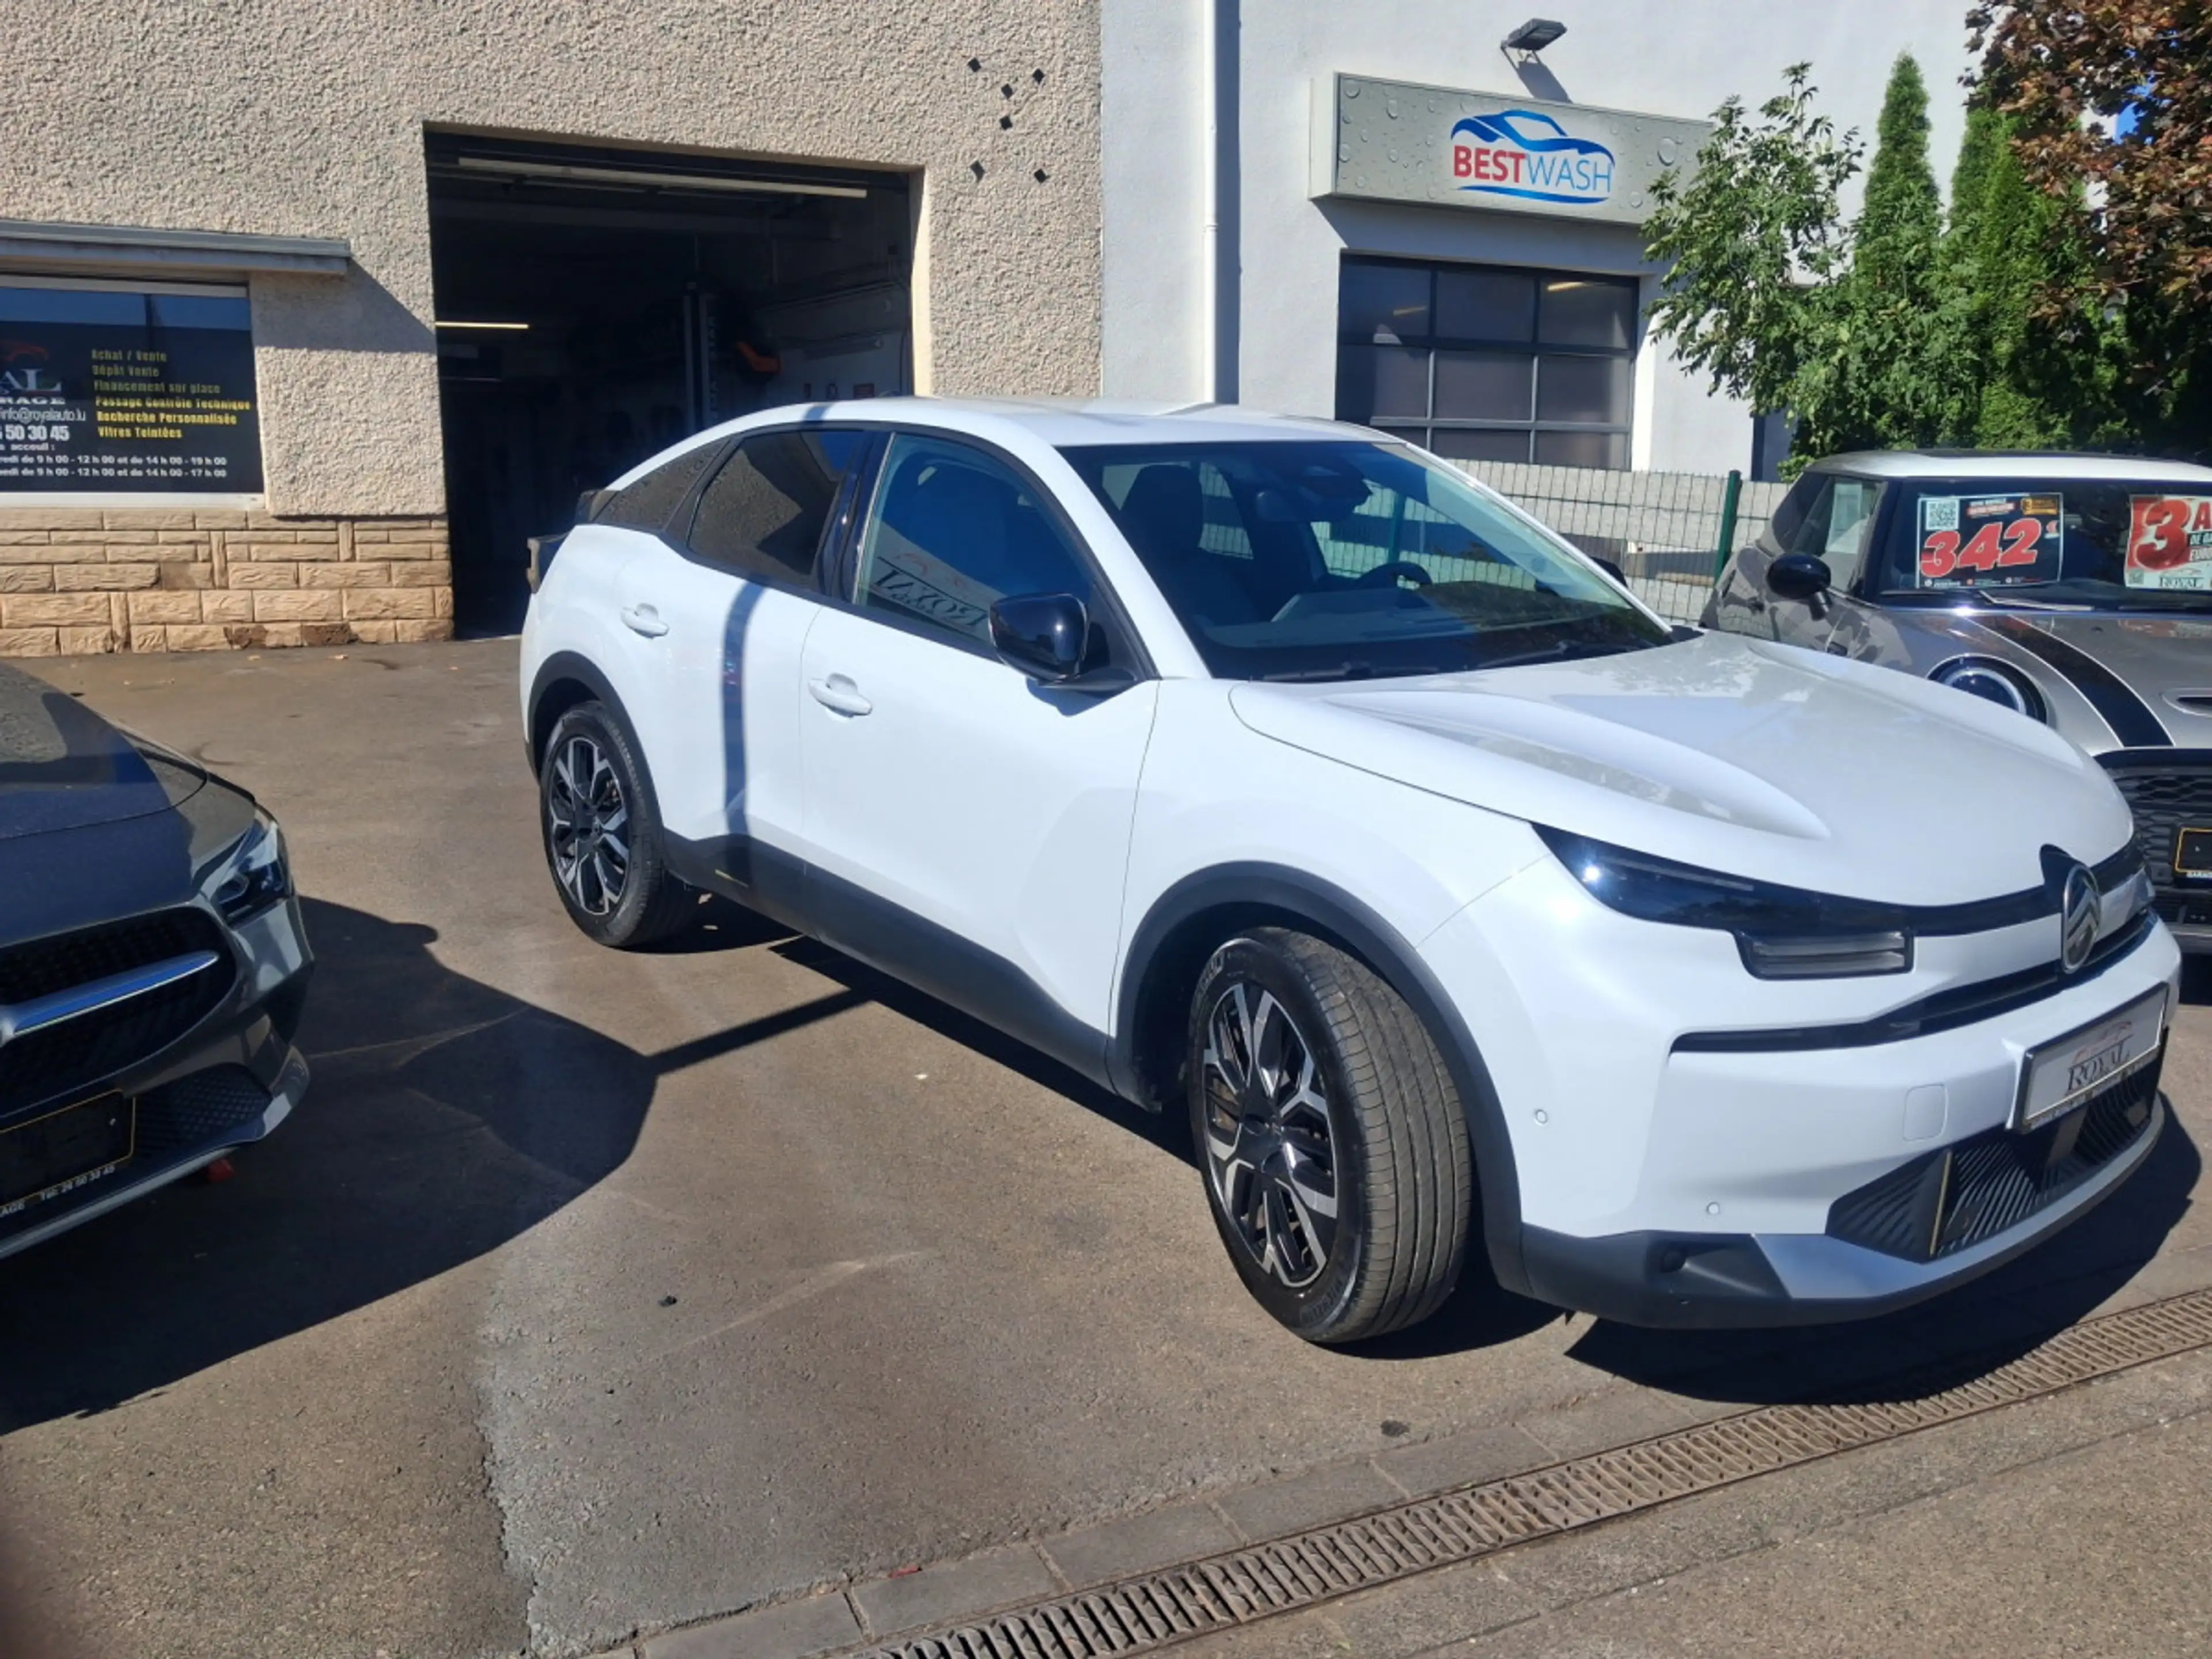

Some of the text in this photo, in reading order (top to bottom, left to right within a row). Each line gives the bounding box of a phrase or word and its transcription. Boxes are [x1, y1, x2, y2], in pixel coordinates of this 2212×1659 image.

[1453, 144, 1611, 192] BESTWASH
[5, 425, 70, 441] 50 30 45
[37, 455, 44, 463] 9
[46, 455, 54, 463] h
[55, 455, 69, 463] 00
[92, 456, 100, 464] h
[101, 456, 115, 464] 00
[169, 456, 183, 464] 00
[37, 468, 44, 476] 9
[46, 468, 54, 476] h
[55, 468, 69, 476] 00
[92, 468, 100, 476] h
[101, 468, 115, 476] 00
[169, 469, 183, 477] 00
[1921, 518, 2042, 578] 342
[2134, 500, 2191, 571] 3
